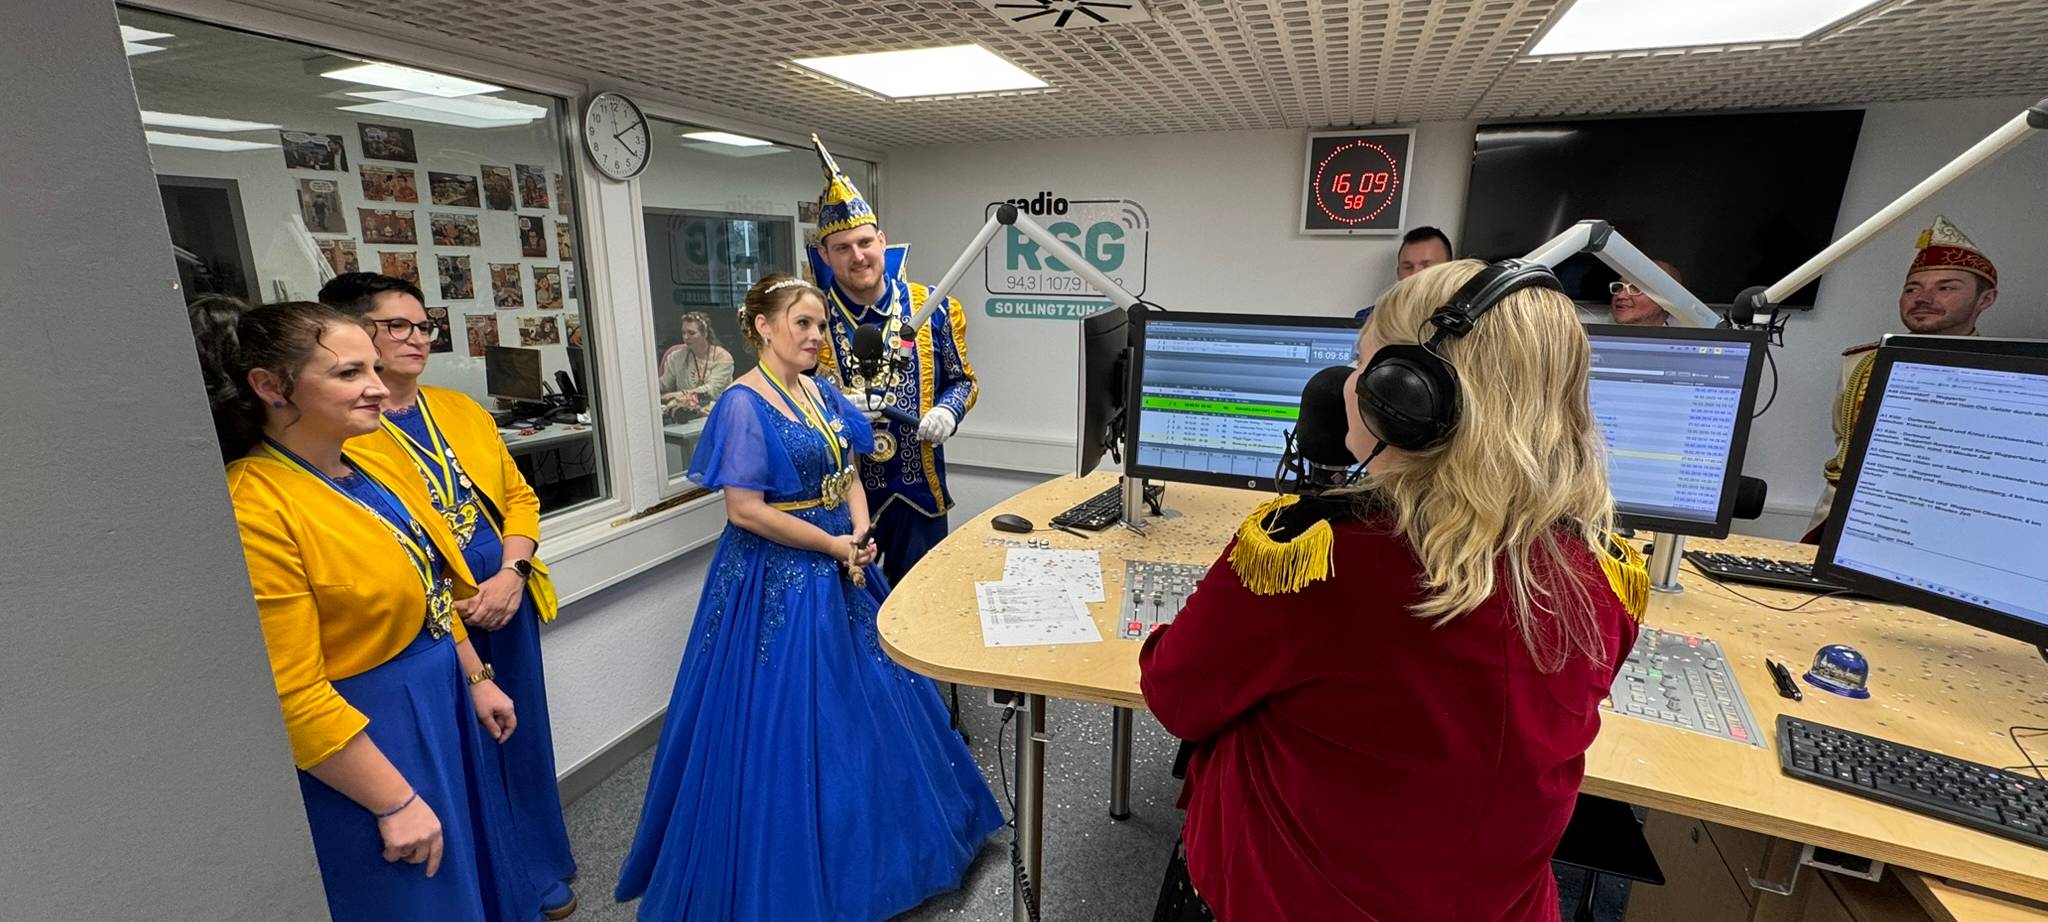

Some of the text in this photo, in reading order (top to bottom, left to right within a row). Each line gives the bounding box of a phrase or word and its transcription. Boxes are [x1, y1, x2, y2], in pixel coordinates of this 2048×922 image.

[592, 113, 601, 123] 10
[588, 126, 595, 136] 9
[635, 135, 640, 145] 3
[593, 142, 599, 152] 8
[602, 153, 608, 163] 7
[625, 158, 631, 168] 5
[614, 160, 620, 170] 6
[1332, 172, 1388, 193] 16 09
[1344, 194, 1364, 209] 58
[1007, 276, 1036, 290] 94,3
[995, 302, 1013, 314] SO
[1015, 302, 1064, 315] KLINGT
